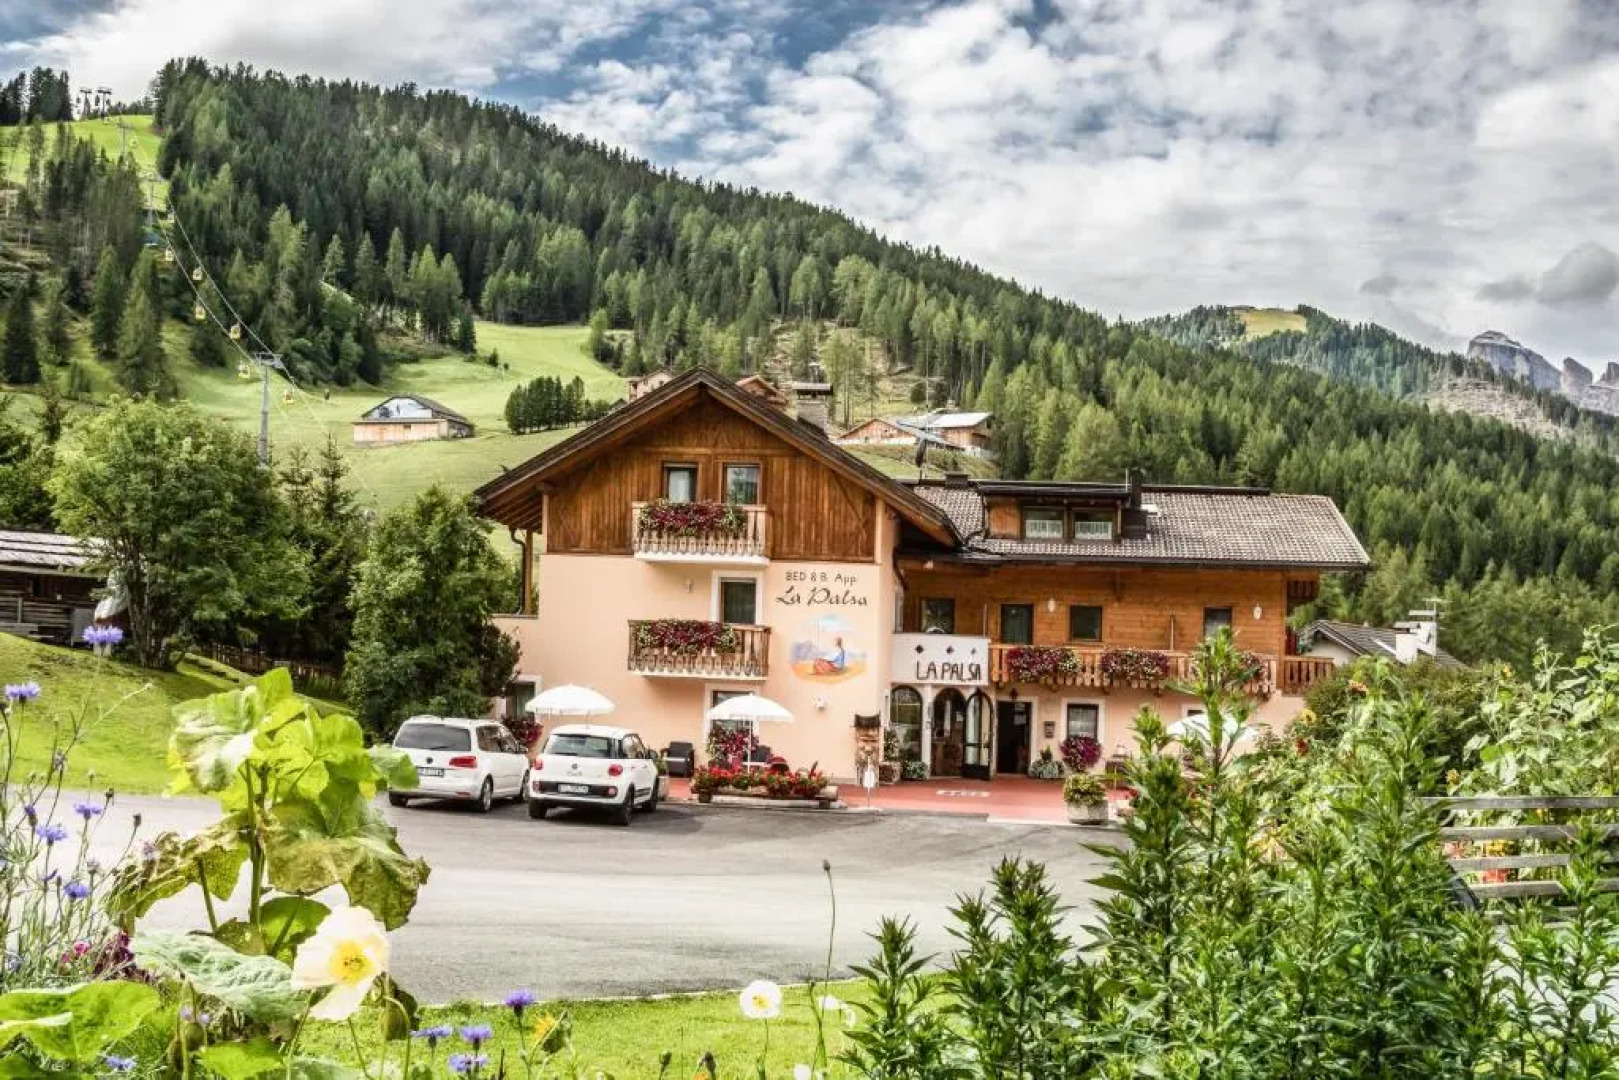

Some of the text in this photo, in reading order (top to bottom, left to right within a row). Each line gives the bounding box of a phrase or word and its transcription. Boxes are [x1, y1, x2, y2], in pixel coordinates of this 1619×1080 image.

[785, 571, 807, 582] BED
[775, 585, 868, 606] La Palsa
[916, 660, 982, 682] LA PALSA
